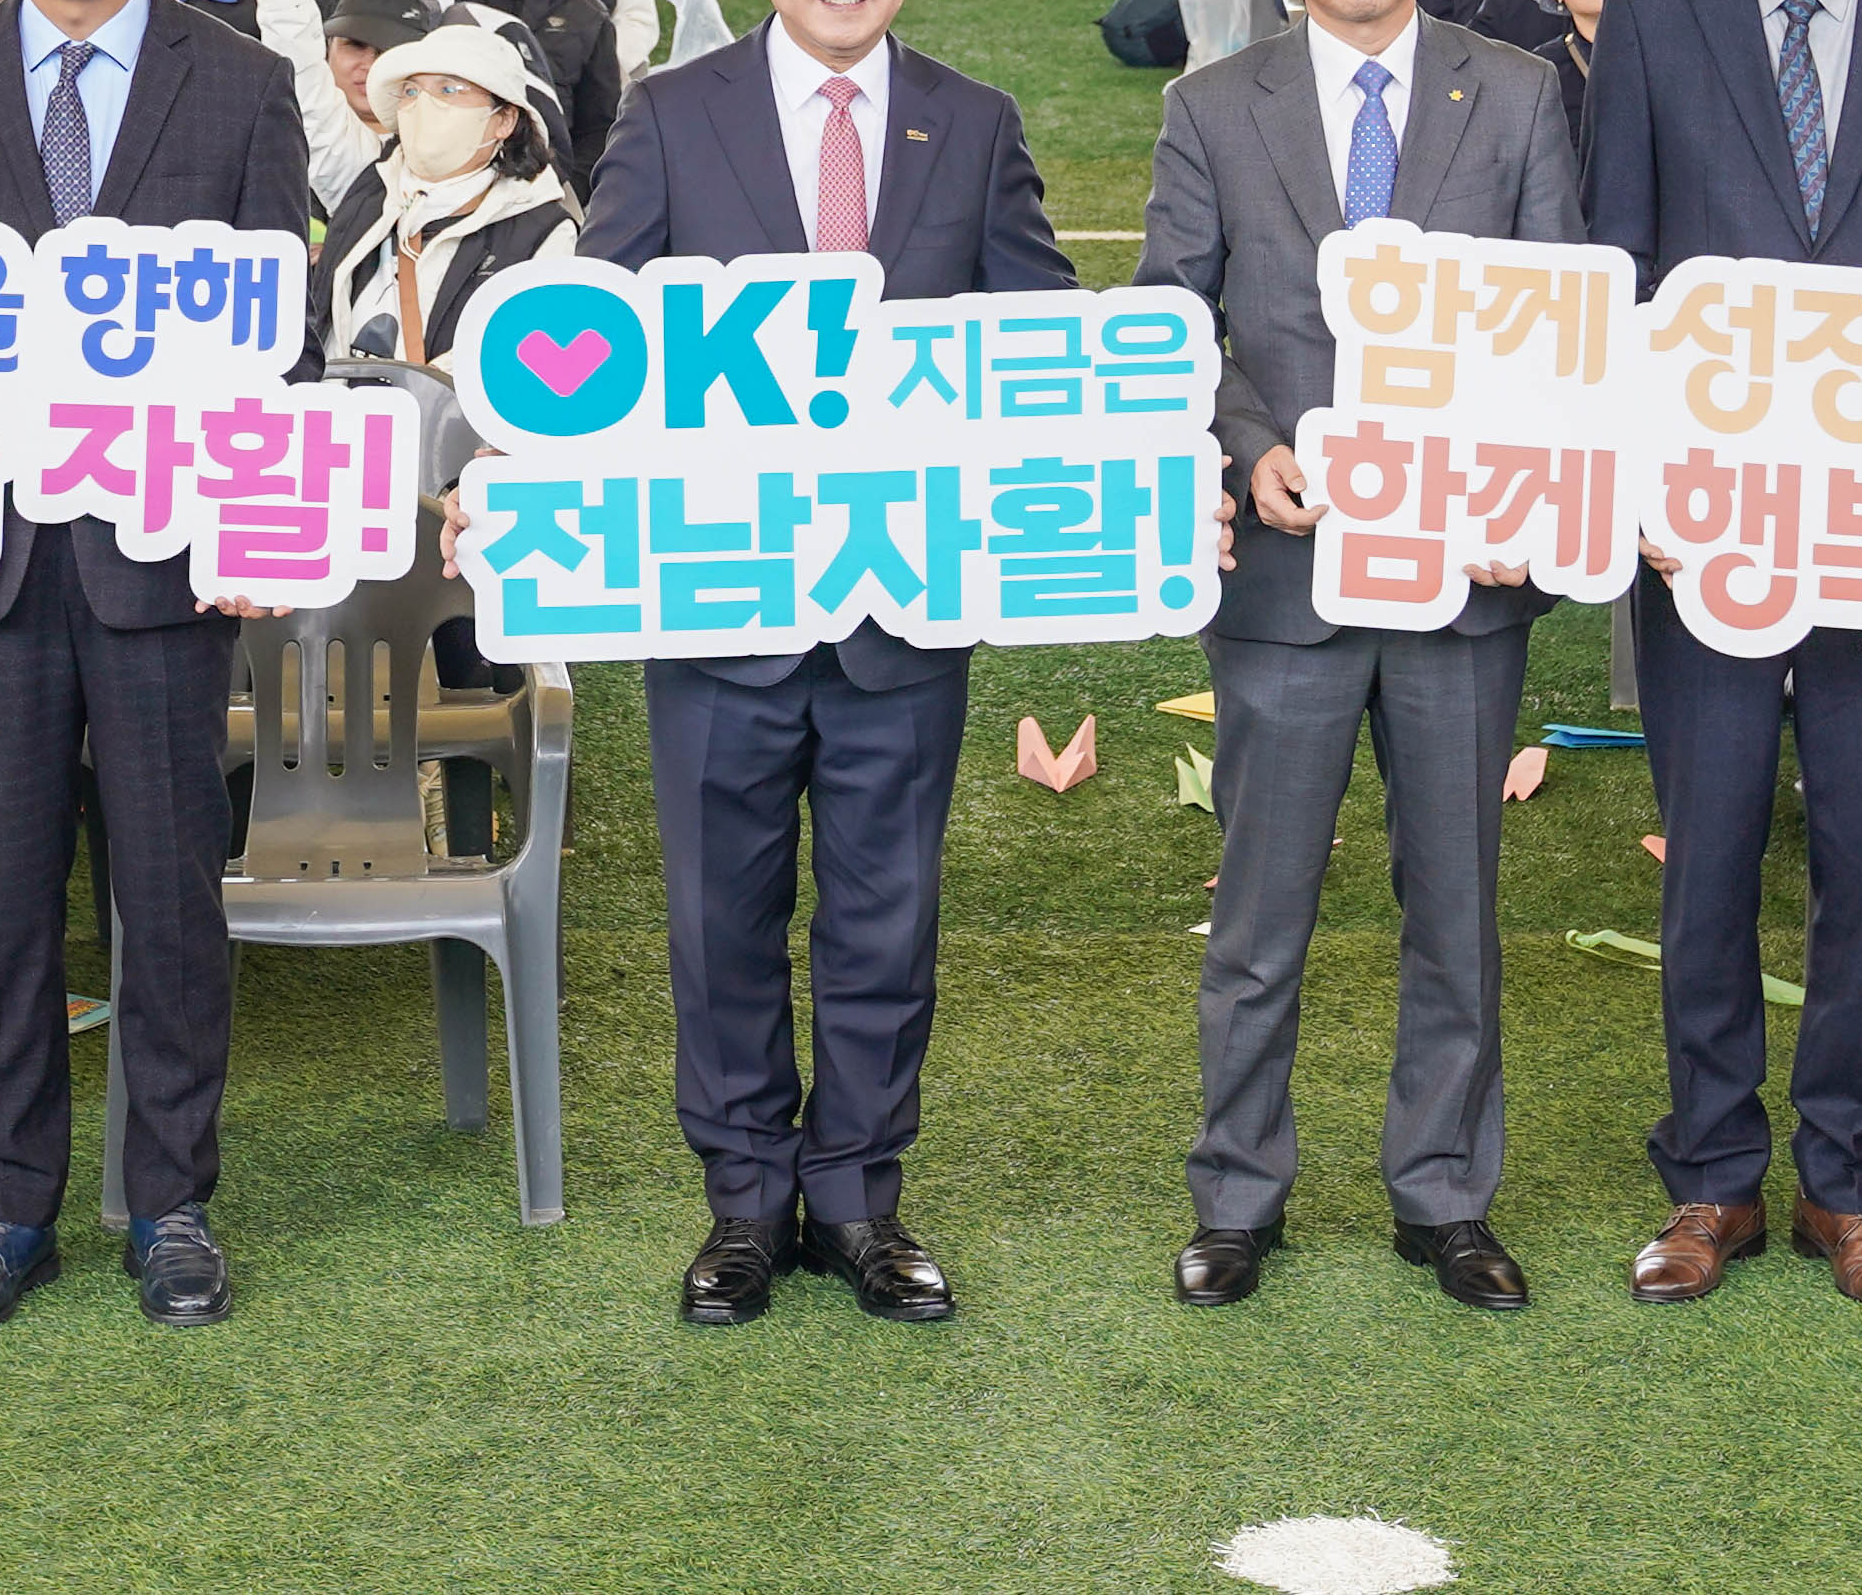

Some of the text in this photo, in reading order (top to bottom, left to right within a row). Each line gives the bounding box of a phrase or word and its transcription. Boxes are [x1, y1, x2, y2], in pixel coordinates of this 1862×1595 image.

[60, 244, 281, 378] 향해
[479, 277, 1195, 438] OK! 지금은
[1344, 244, 1610, 410] 함께
[41, 396, 393, 581] 자활!
[480, 454, 1196, 637] 전남자활!
[1322, 420, 1616, 605] 함께
